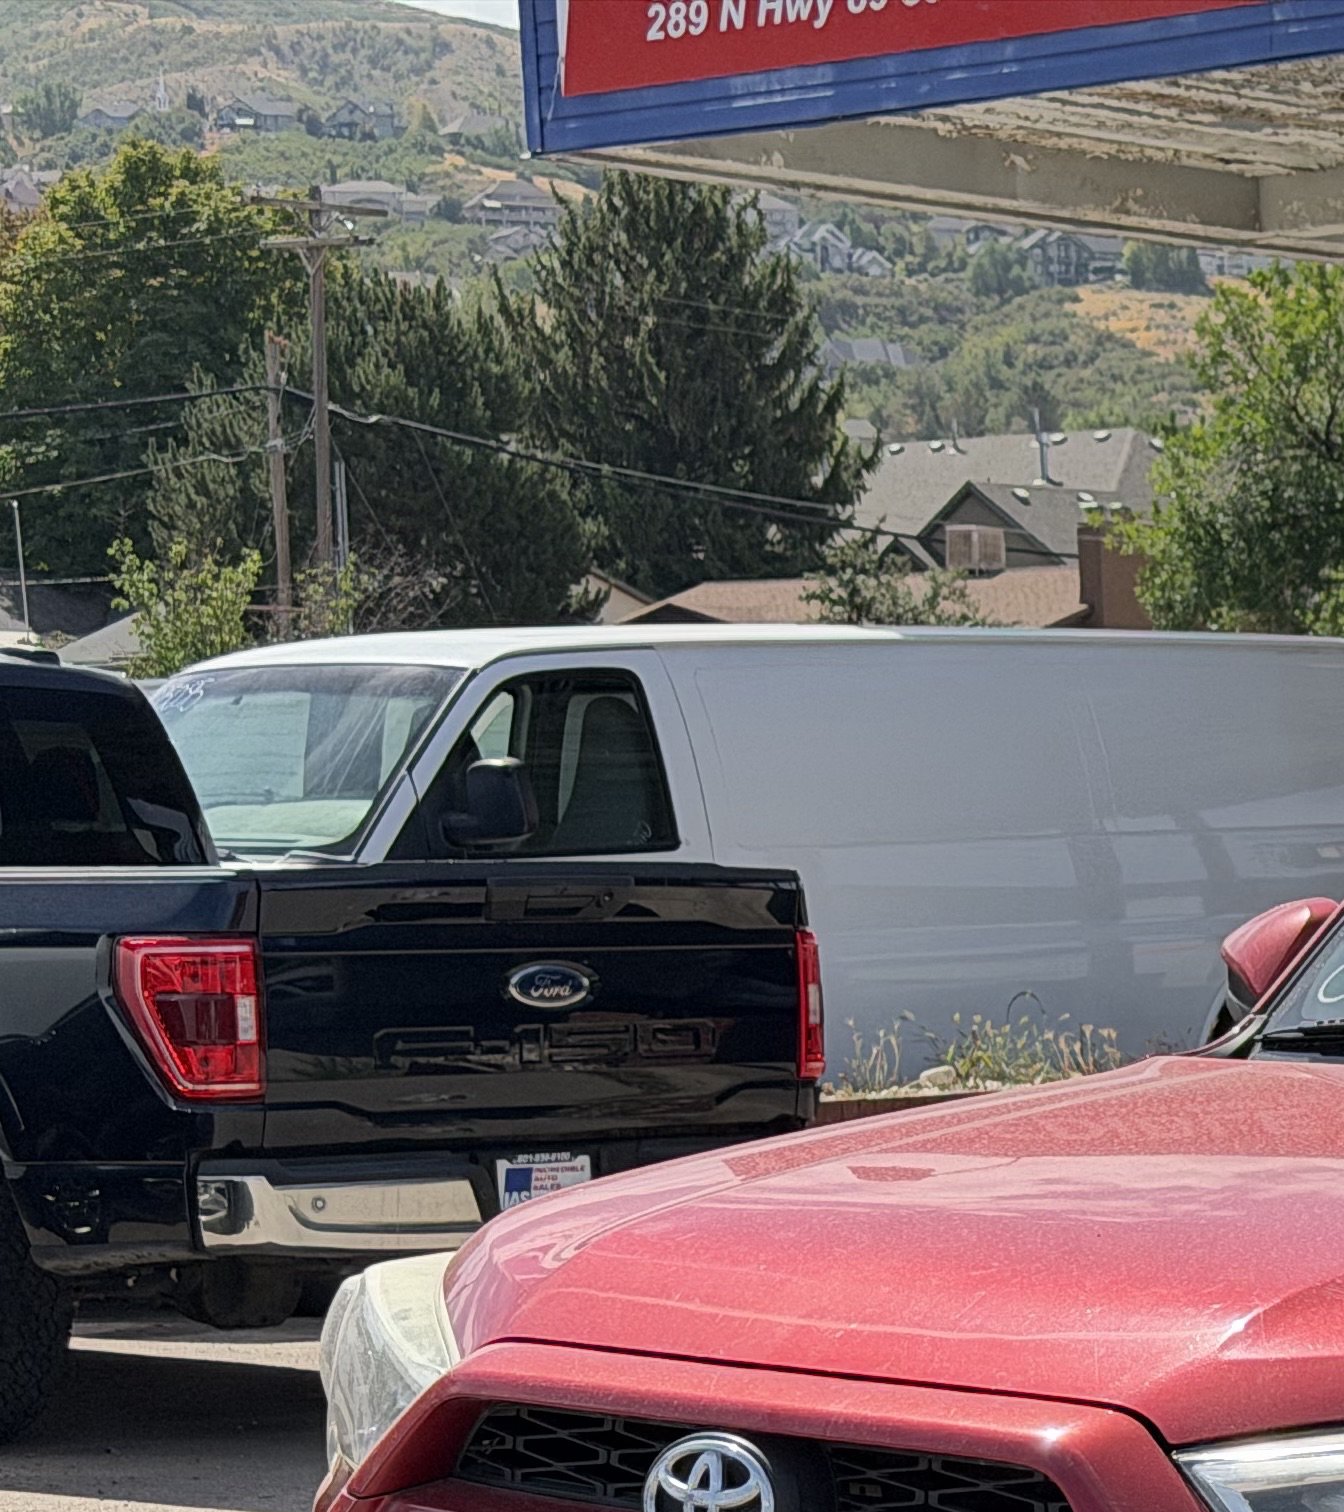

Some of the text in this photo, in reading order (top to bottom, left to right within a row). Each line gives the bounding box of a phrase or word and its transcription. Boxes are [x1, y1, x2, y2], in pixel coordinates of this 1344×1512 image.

[646, 0, 709, 41] 289
[719, 0, 747, 32] N
[757, 0, 834, 29] Hwy
[529, 973, 575, 998] Ford
